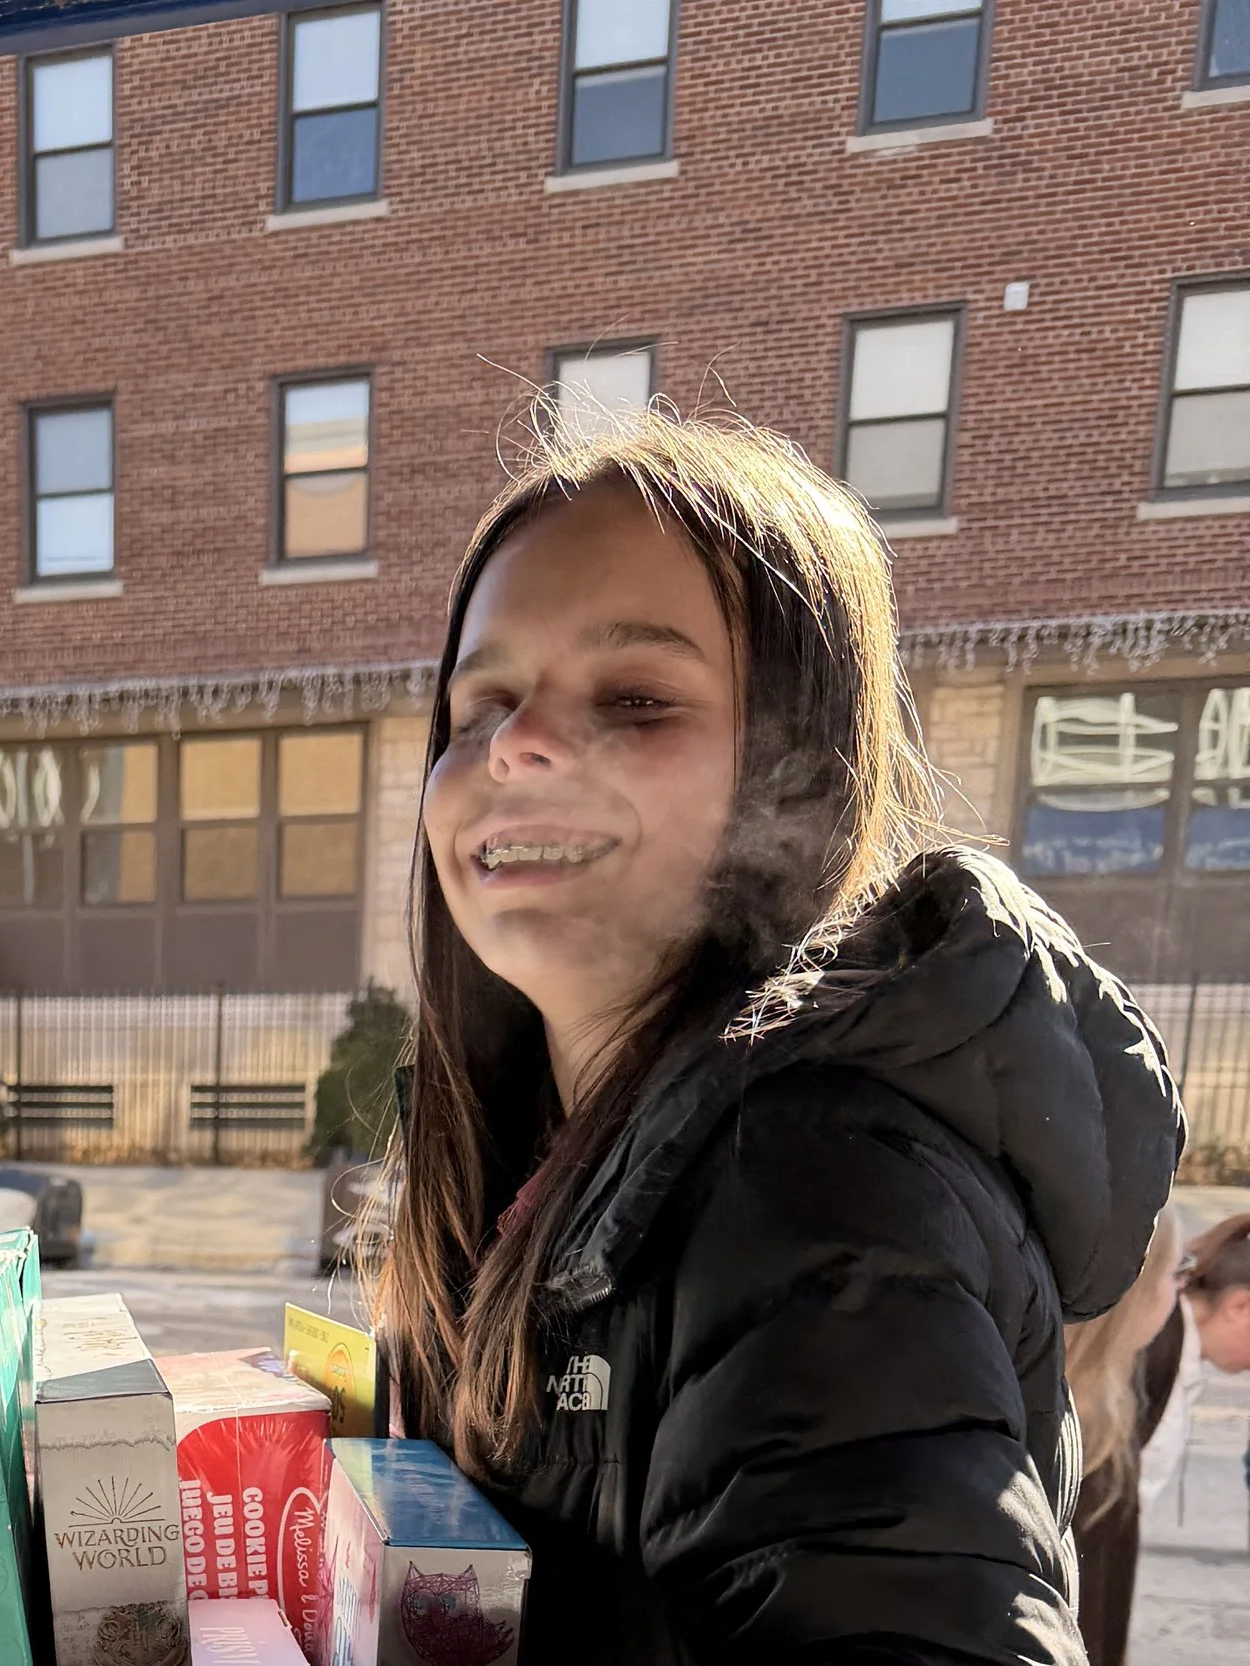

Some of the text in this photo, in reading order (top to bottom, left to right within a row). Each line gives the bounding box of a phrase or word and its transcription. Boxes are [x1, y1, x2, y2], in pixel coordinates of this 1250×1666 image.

[179, 1479, 205, 1553] JUEGO
[207, 1492, 234, 1535] JEU
[243, 1487, 267, 1577] COOKIE
[53, 1524, 180, 1549] WIZARDING
[216, 1538, 237, 1569] DE
[290, 1506, 315, 1588] Melissa
[72, 1546, 166, 1571] WORLD
[187, 1556, 207, 1588] DE
